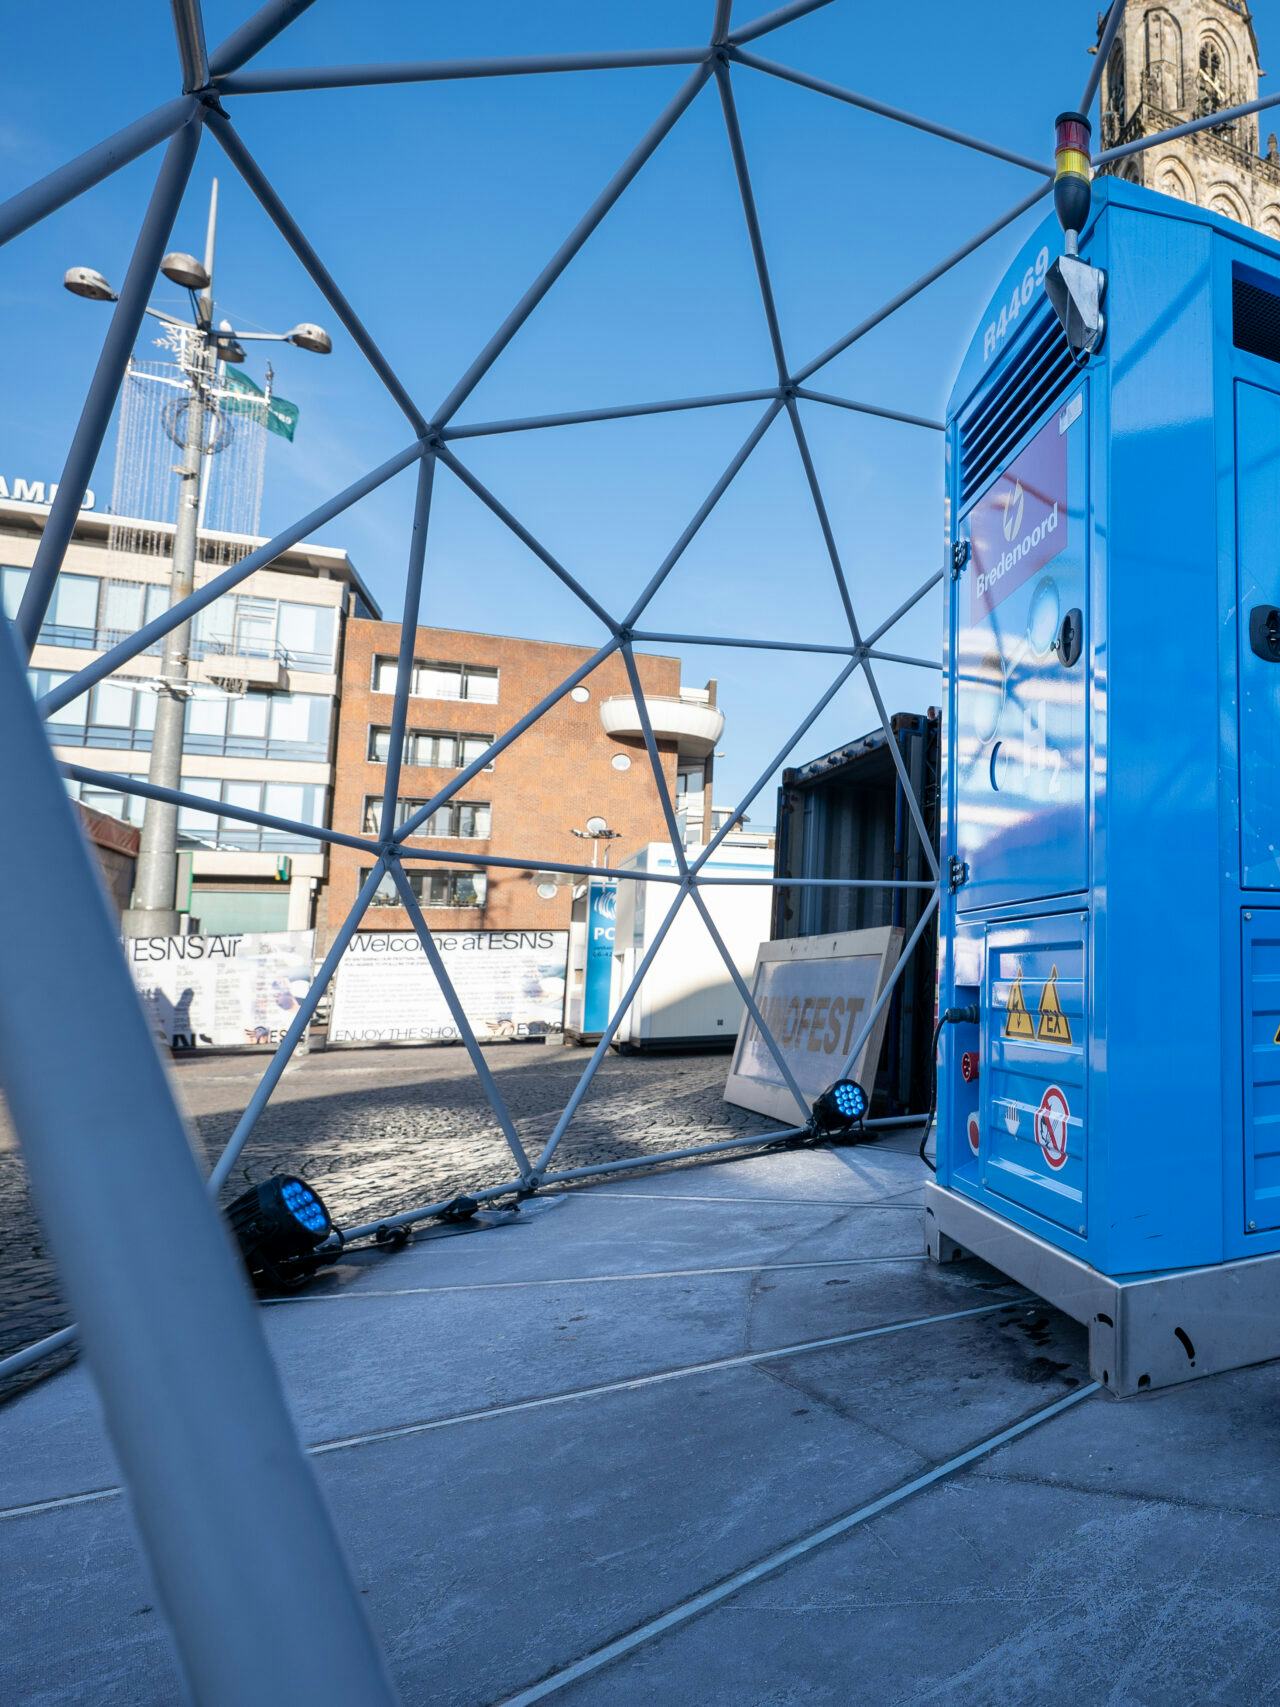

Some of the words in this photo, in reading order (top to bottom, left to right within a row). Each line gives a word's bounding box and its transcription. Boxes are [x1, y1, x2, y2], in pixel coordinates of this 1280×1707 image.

[983, 246, 1049, 361] R4469
[976, 501, 1058, 599] Bredenoord
[133, 935, 205, 962] ESNS
[208, 935, 242, 959] Air
[462, 934, 484, 951] at
[488, 932, 554, 950] ESNS
[335, 1028, 386, 1042] ENJOY
[388, 1027, 418, 1041] THE
